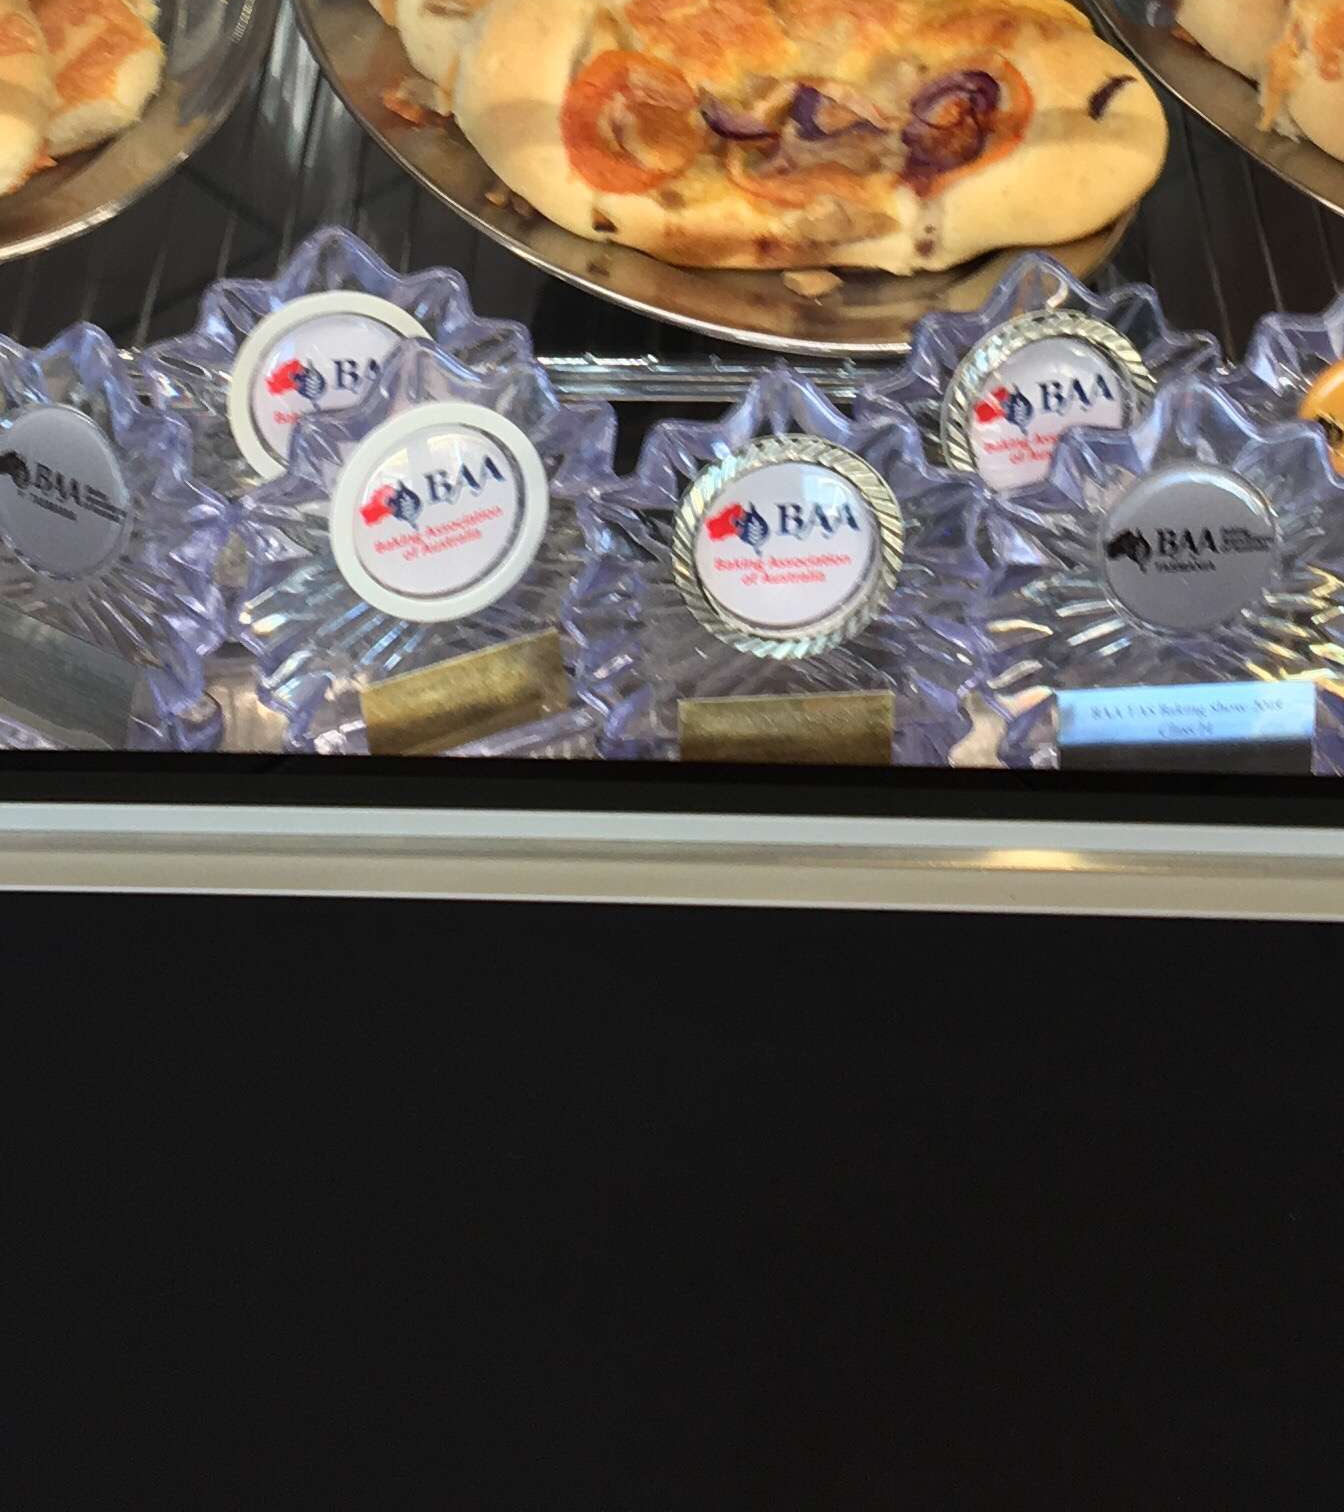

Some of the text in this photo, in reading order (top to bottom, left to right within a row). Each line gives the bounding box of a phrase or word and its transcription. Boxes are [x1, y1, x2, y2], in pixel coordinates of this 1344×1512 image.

[1037, 374, 1115, 417] BAA
[424, 454, 506, 505] BAA
[774, 501, 861, 541] BAA
[1155, 527, 1220, 561] BAA
